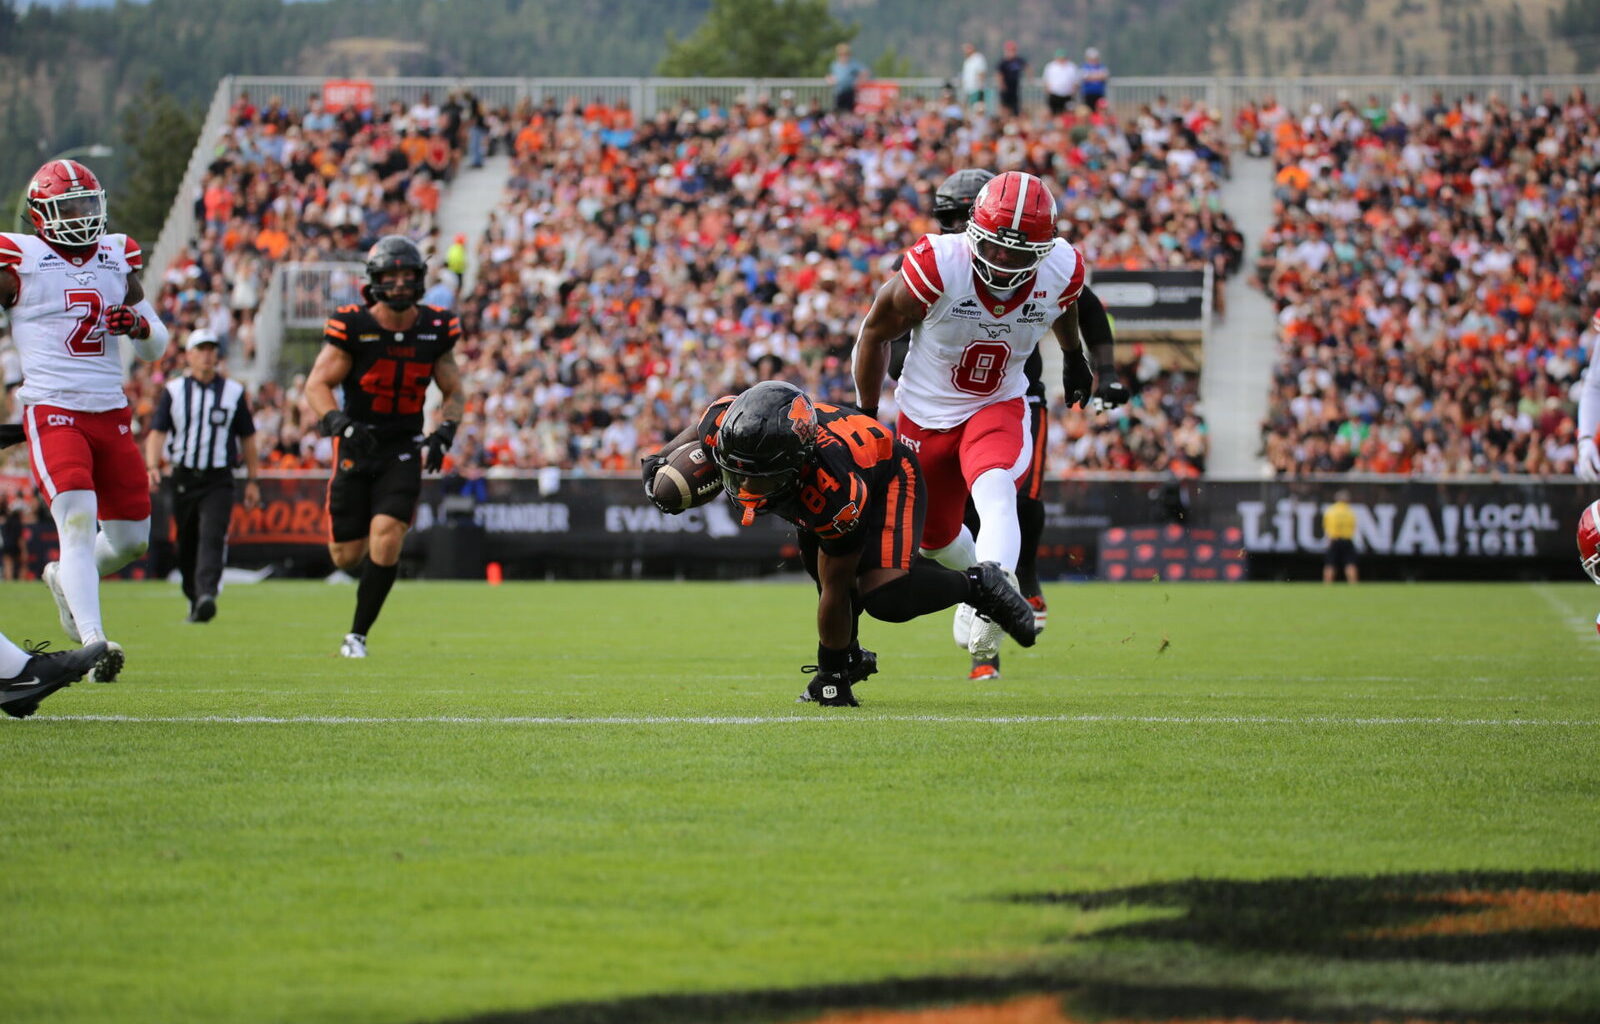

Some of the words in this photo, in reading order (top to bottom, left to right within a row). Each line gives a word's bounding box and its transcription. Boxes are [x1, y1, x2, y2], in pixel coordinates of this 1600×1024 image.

[64, 289, 105, 357] 2
[952, 307, 982, 317] Western
[358, 358, 433, 414] 45
[951, 340, 1012, 397] 8
[801, 467, 840, 514] 84
[1463, 503, 1558, 531] LOCAL
